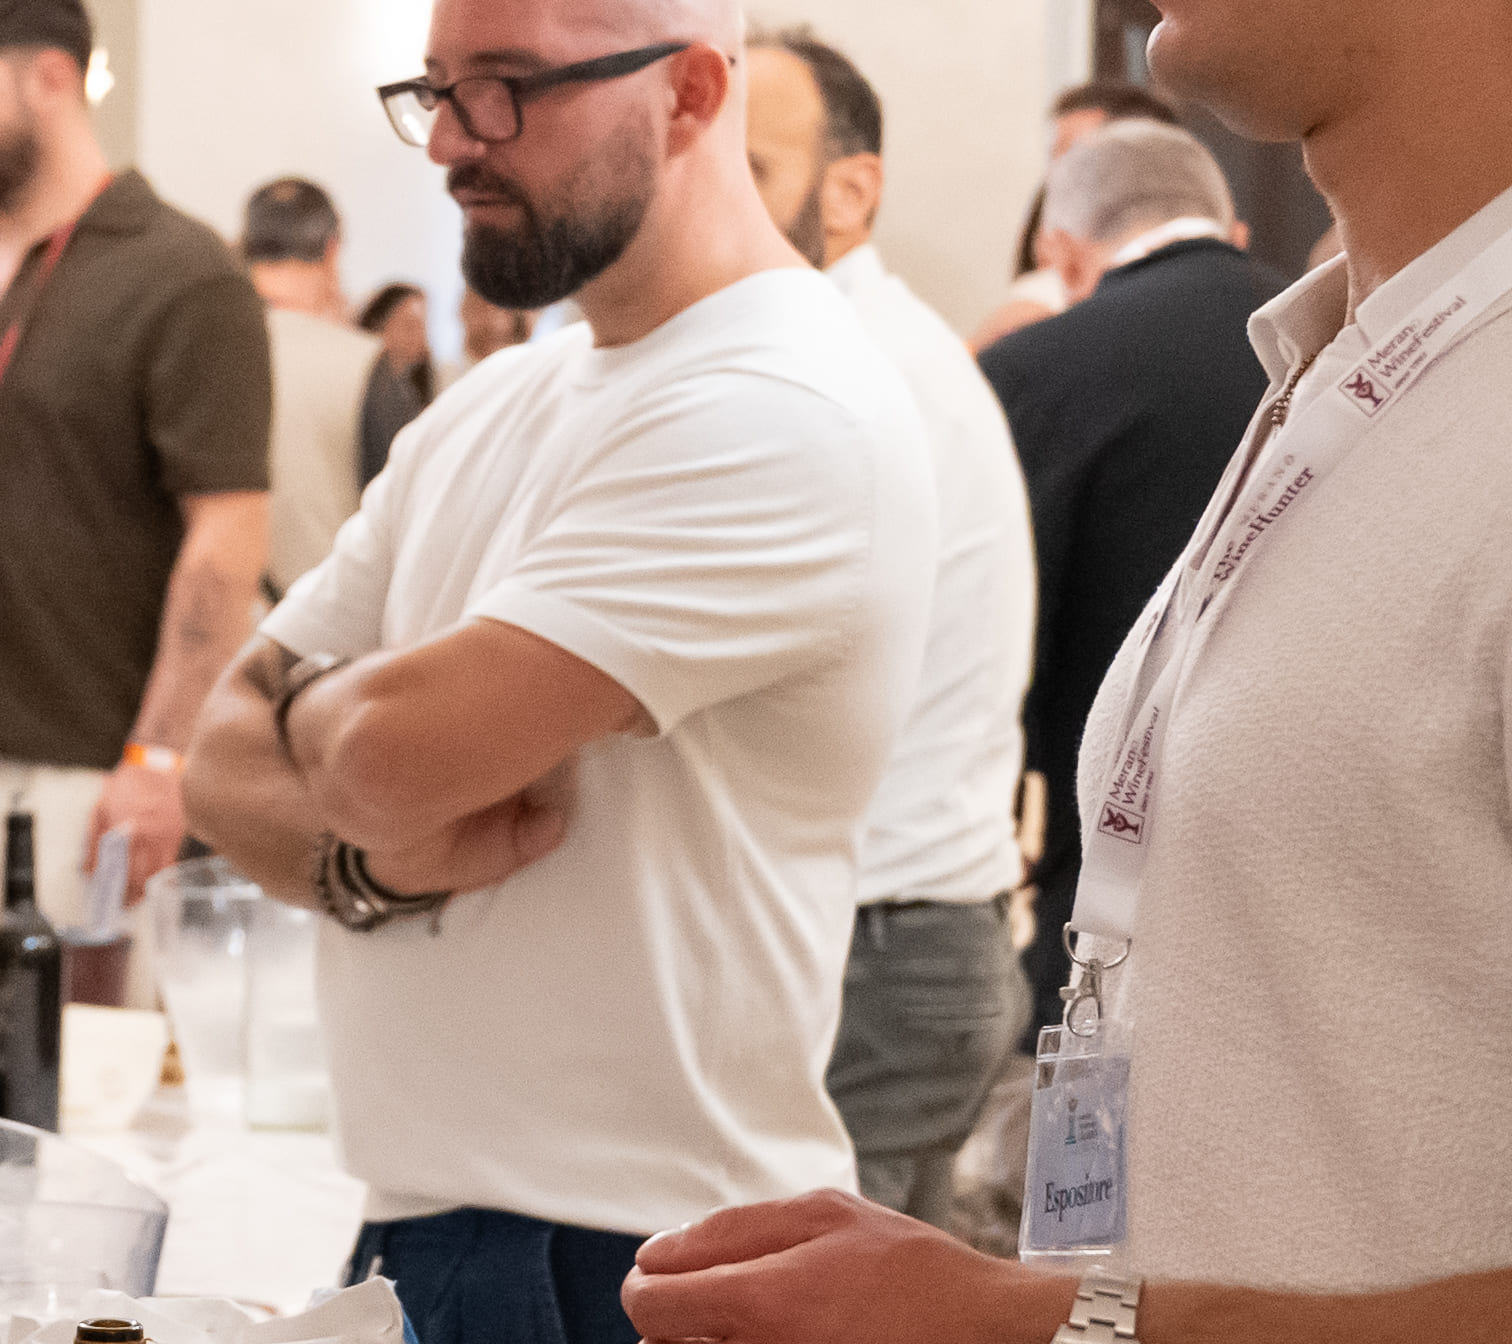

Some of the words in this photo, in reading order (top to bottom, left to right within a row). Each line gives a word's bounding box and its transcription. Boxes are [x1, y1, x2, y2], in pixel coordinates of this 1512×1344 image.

[1378, 295, 1467, 377] WineFestival
[1219, 467, 1314, 582] WineHunter
[1122, 706, 1160, 805] WineFestival
[1045, 1172, 1113, 1222] Espositore
